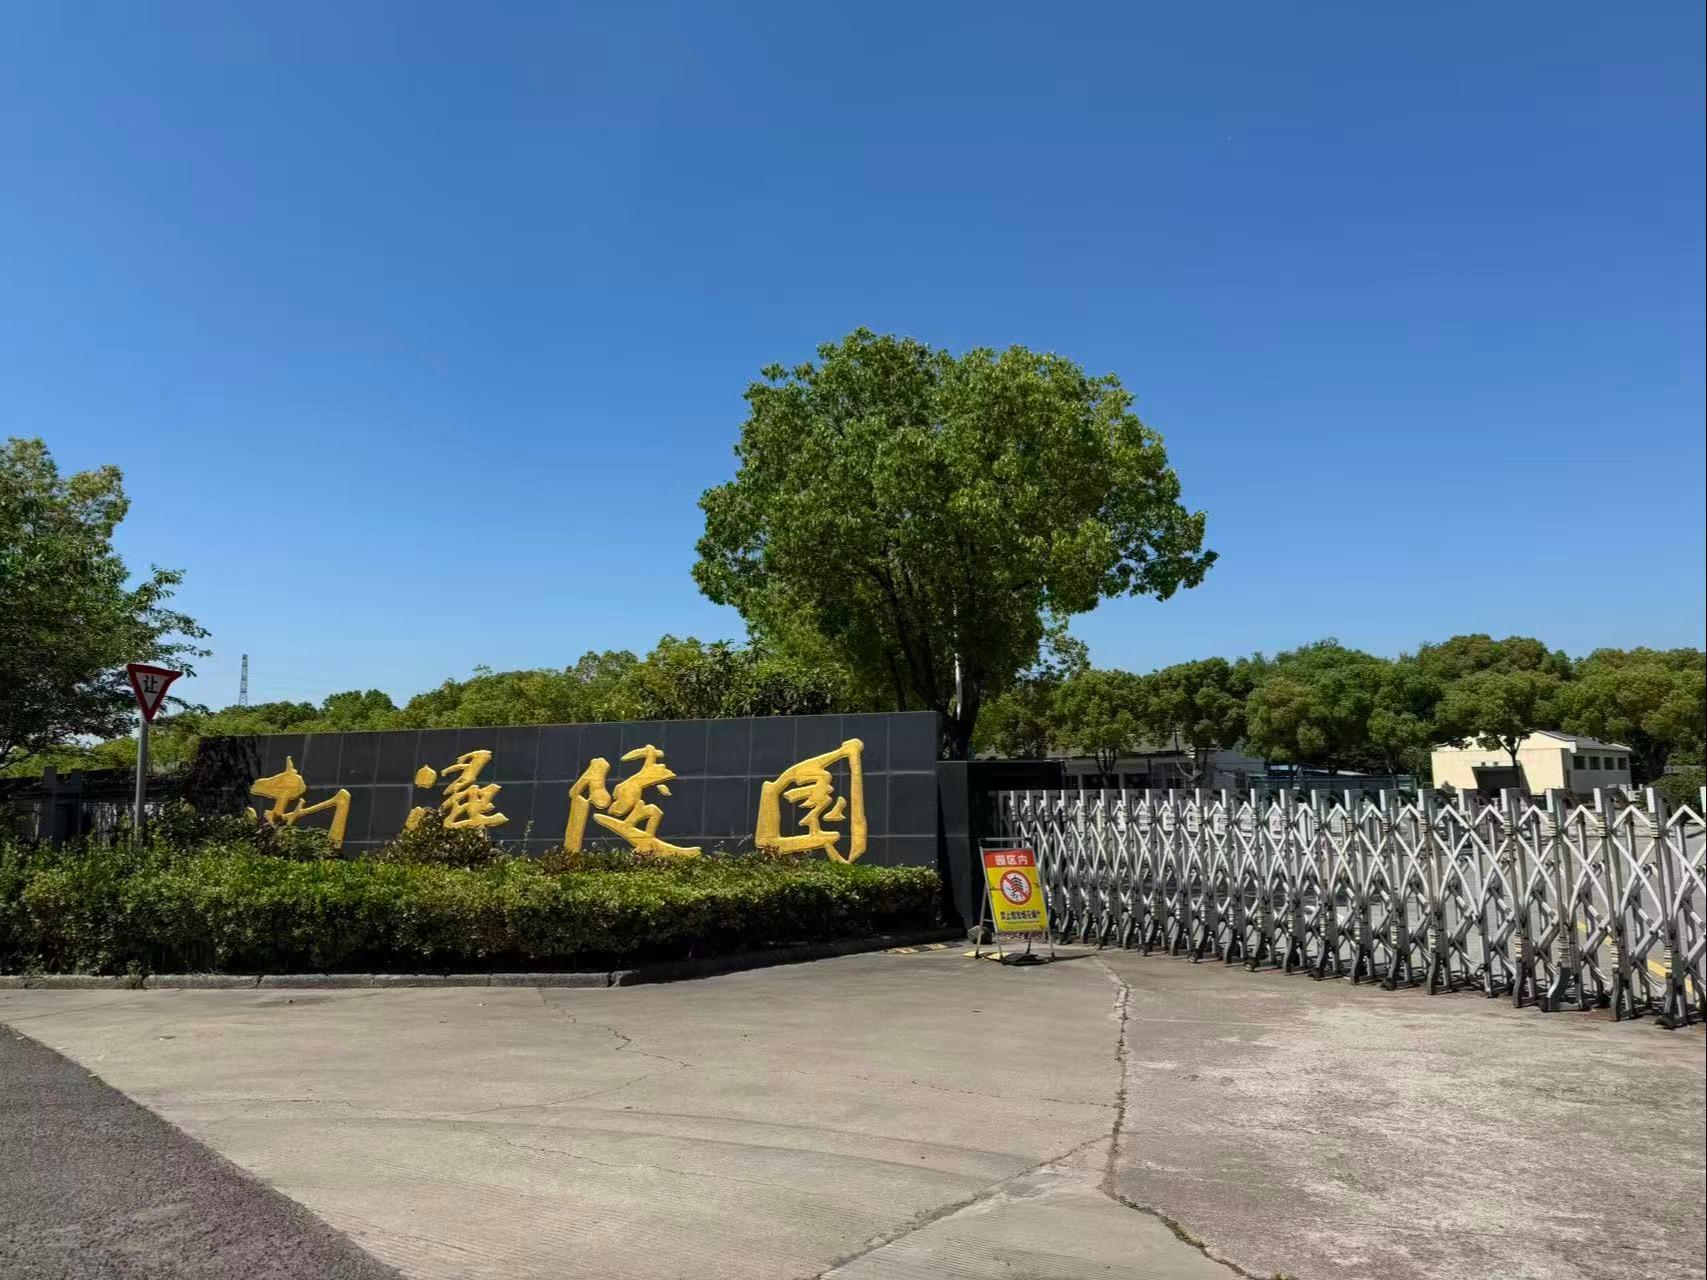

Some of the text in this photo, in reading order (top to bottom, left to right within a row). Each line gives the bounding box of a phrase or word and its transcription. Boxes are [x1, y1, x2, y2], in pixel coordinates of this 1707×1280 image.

[143, 675, 158, 693] 让
[994, 854, 1029, 866] 园区内
